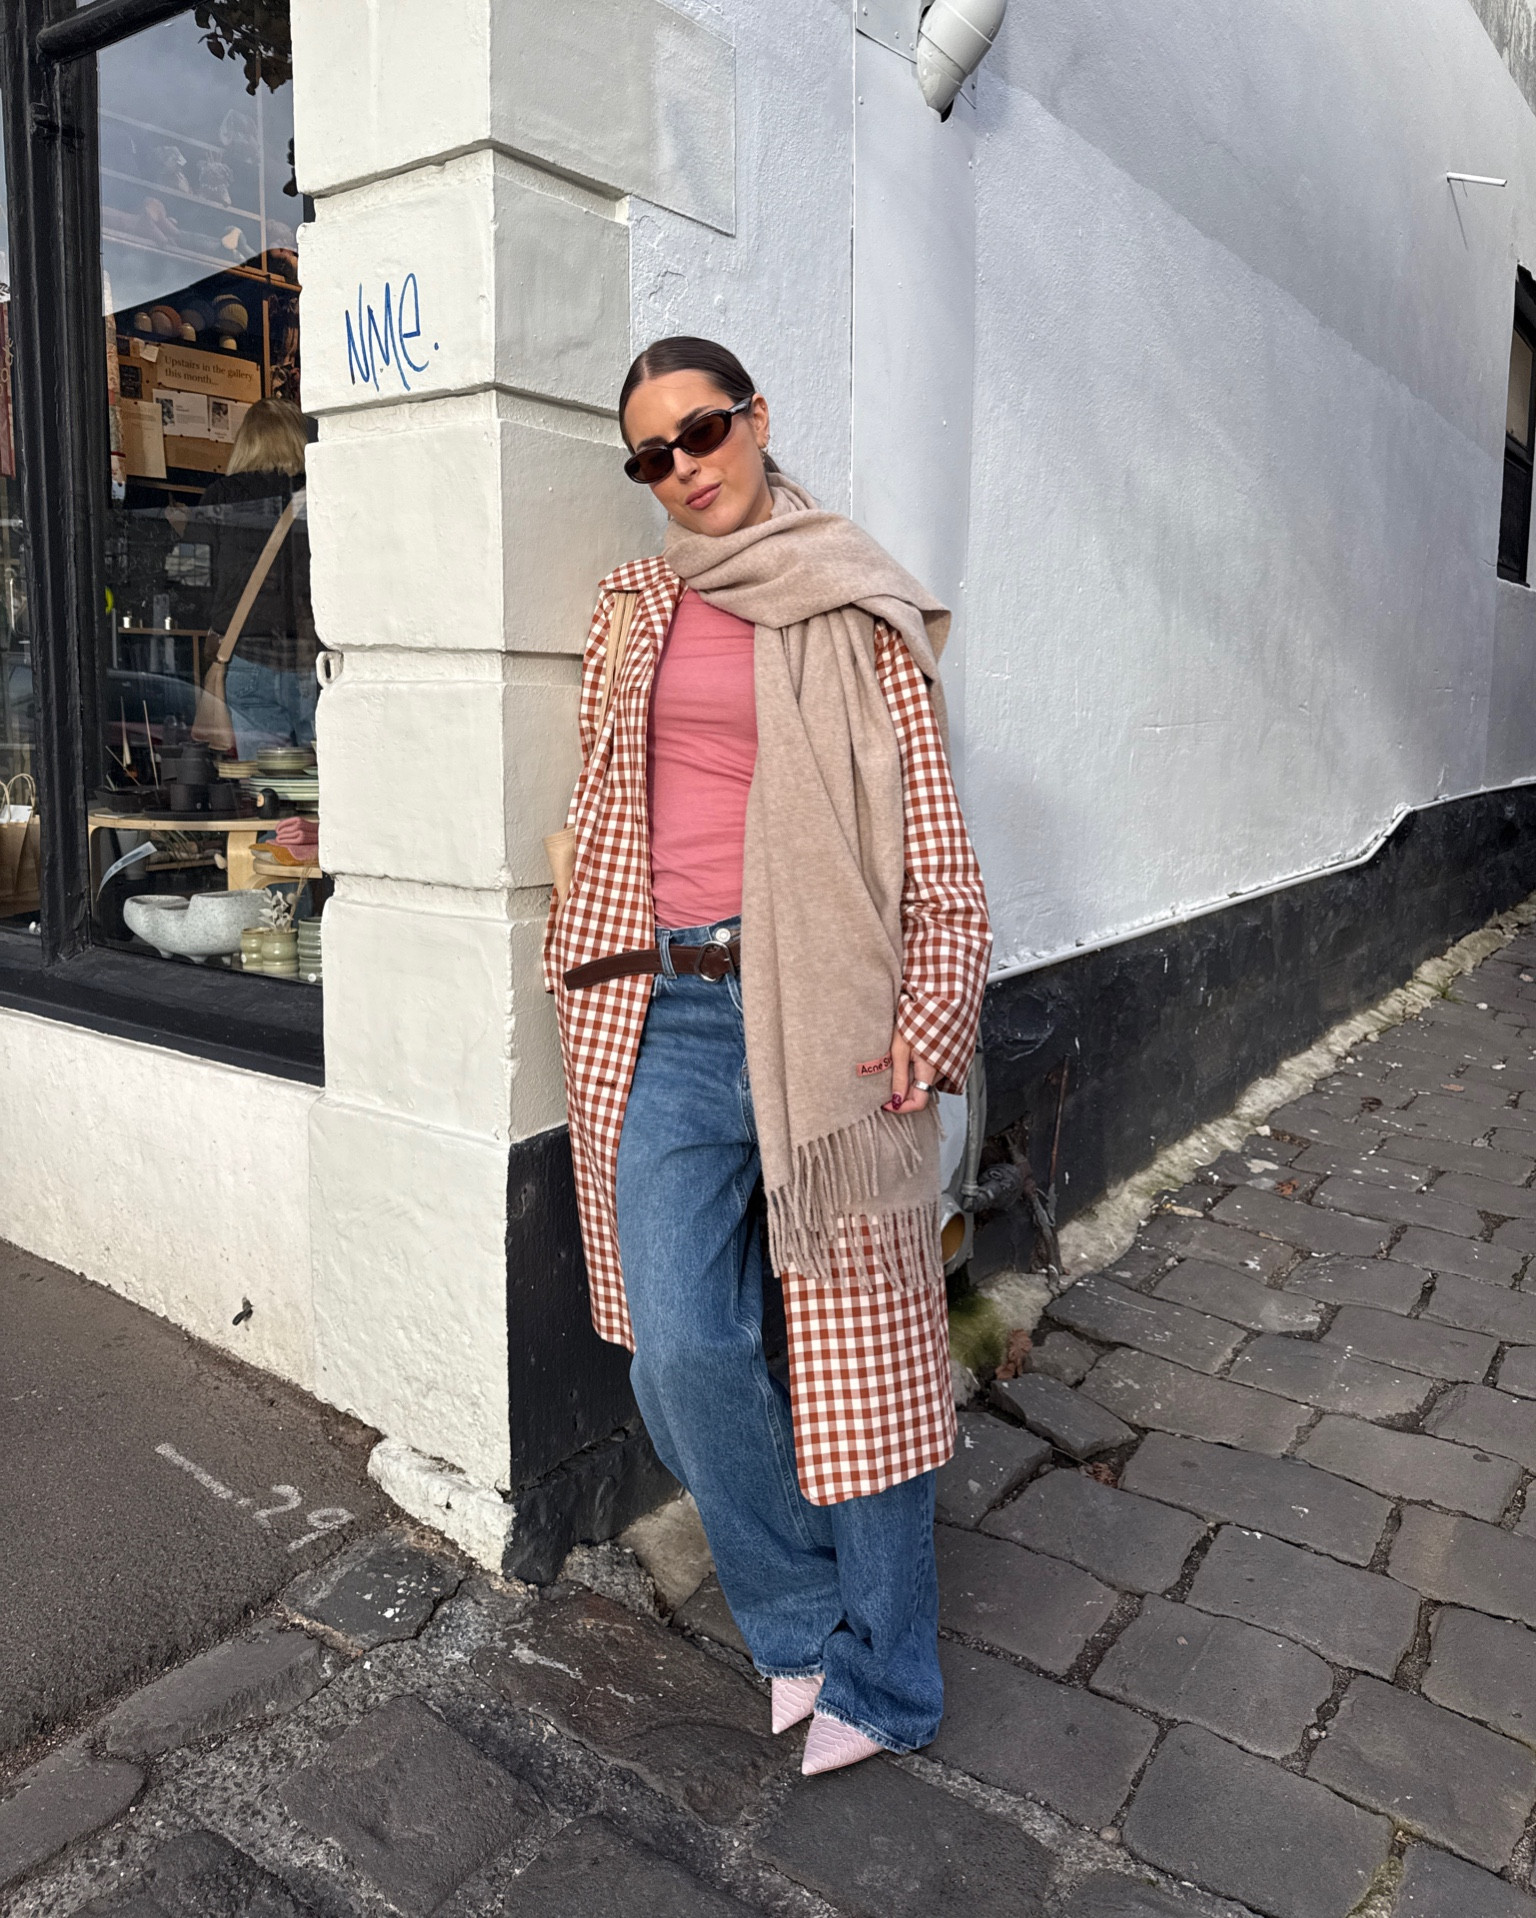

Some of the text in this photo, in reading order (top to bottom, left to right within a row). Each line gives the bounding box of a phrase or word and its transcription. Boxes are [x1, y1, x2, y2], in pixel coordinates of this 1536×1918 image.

[164, 356, 253, 382] Upstairs in the gallery
[165, 368, 182, 379] this
[861, 1064, 883, 1074] Acne
